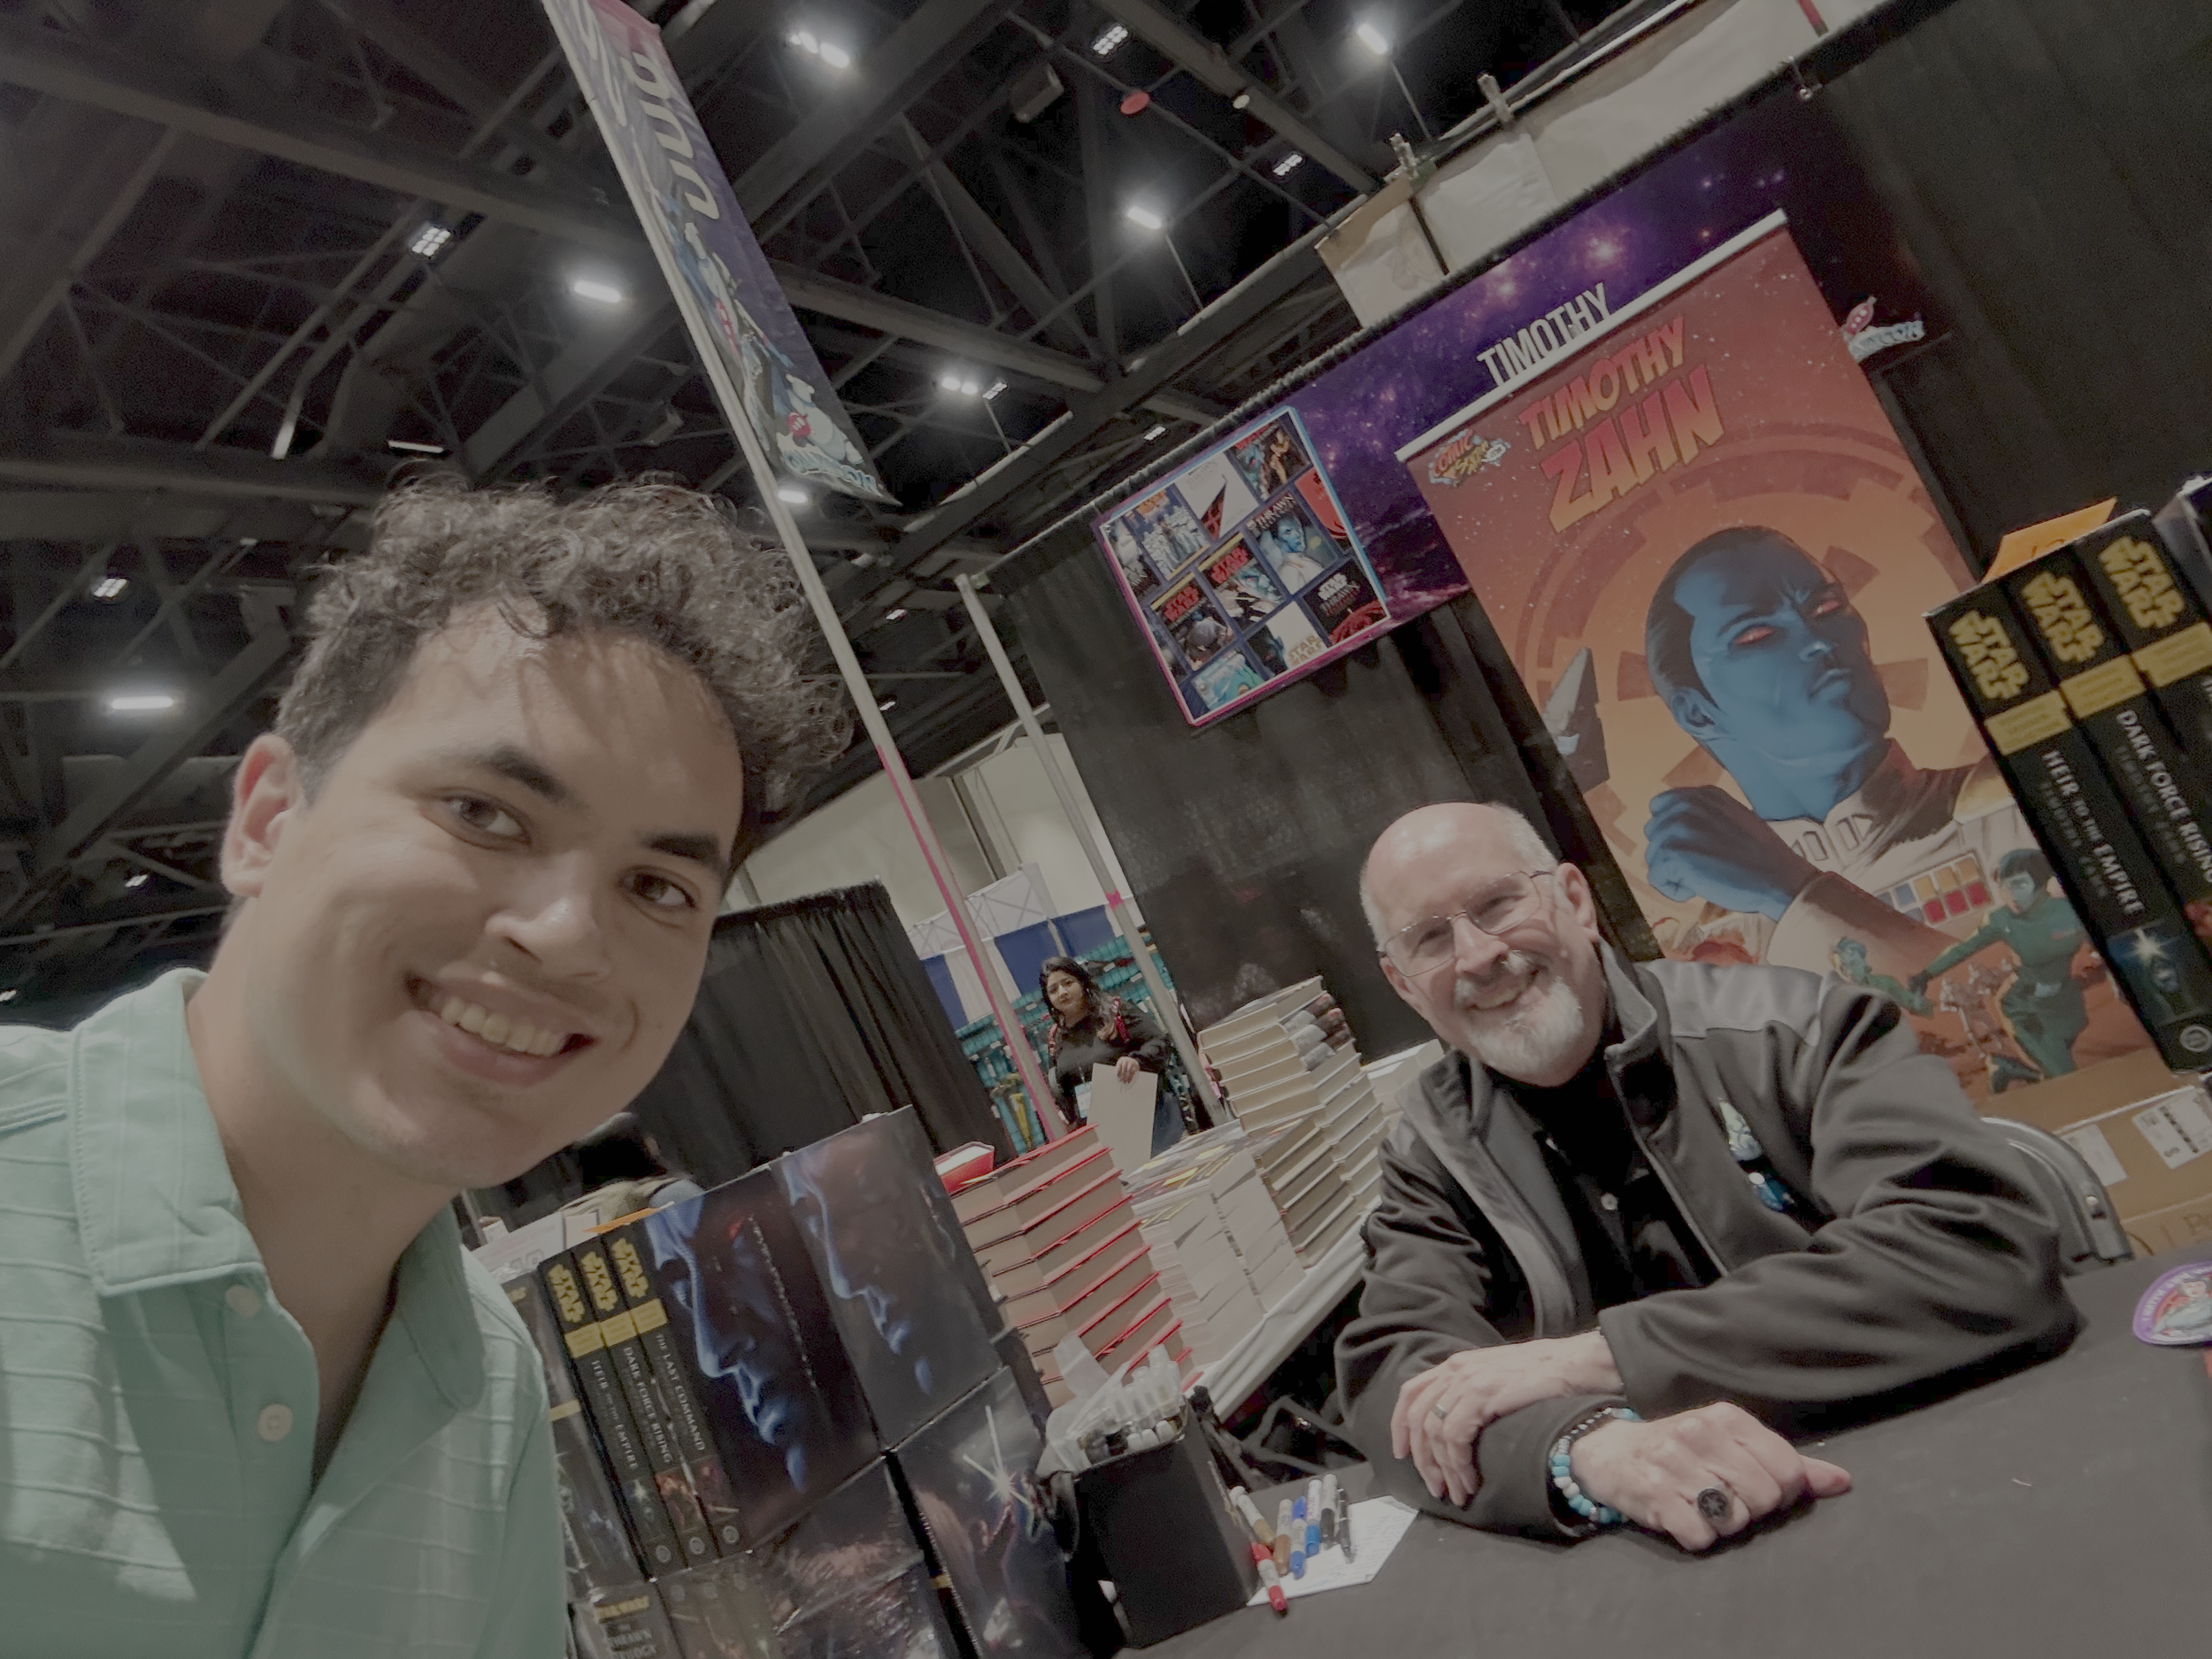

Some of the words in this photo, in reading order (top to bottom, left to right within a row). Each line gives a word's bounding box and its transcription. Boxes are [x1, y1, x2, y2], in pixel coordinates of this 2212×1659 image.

[1477, 282, 1612, 386] TIMOTHY
[1518, 314, 1686, 449] TIMOTHY
[1540, 363, 1724, 534] ZAHN
[2022, 572, 2077, 662] WARS
[2050, 575, 2104, 661] STAR
[2099, 536, 2154, 628] WARS
[2127, 541, 2185, 628] STAR
[1948, 609, 2002, 699] WARS
[1975, 615, 2030, 699] STAR
[2118, 709, 2156, 762] DARK
[2146, 760, 2193, 819] FORCE
[2044, 749, 2079, 796] HEIR
[2093, 842, 2145, 915] EMPIRE
[591, 1360, 608, 1389] HEIR
[615, 1424, 639, 1471] EMPIRE
[623, 1347, 641, 1379] DARK
[637, 1381, 657, 1419] FORCE
[650, 1422, 672, 1463] RISING
[664, 1354, 679, 1381] LAST
[674, 1385, 705, 1452] COMMAND
